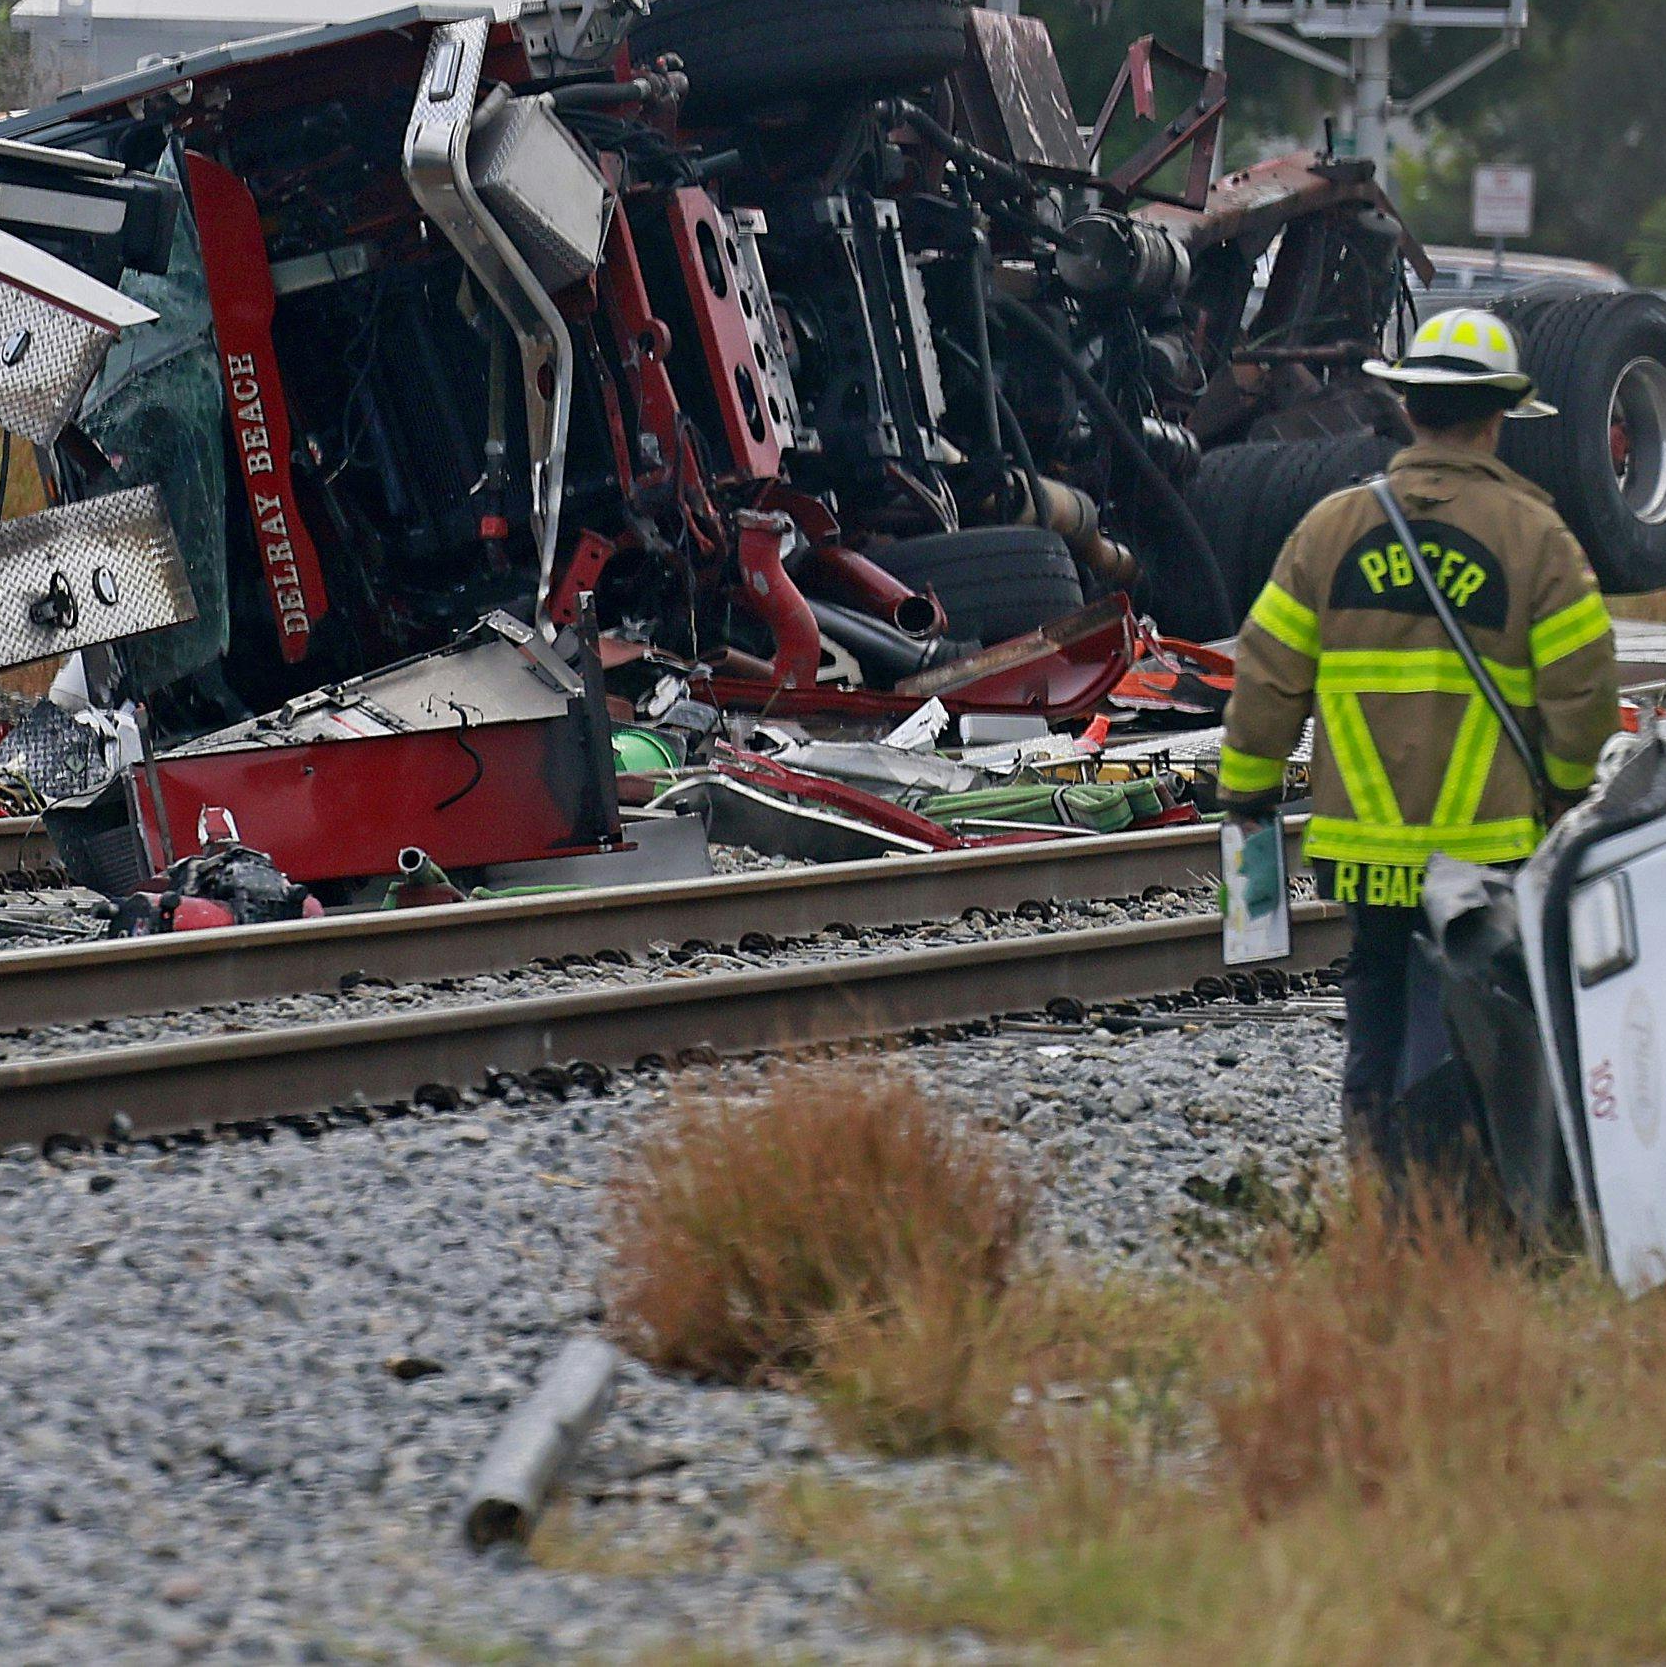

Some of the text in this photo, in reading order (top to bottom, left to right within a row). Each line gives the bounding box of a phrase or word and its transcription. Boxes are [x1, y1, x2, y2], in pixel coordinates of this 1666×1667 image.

[227, 352, 310, 637] DELRAY BEACH
[1335, 861, 1359, 903] R
